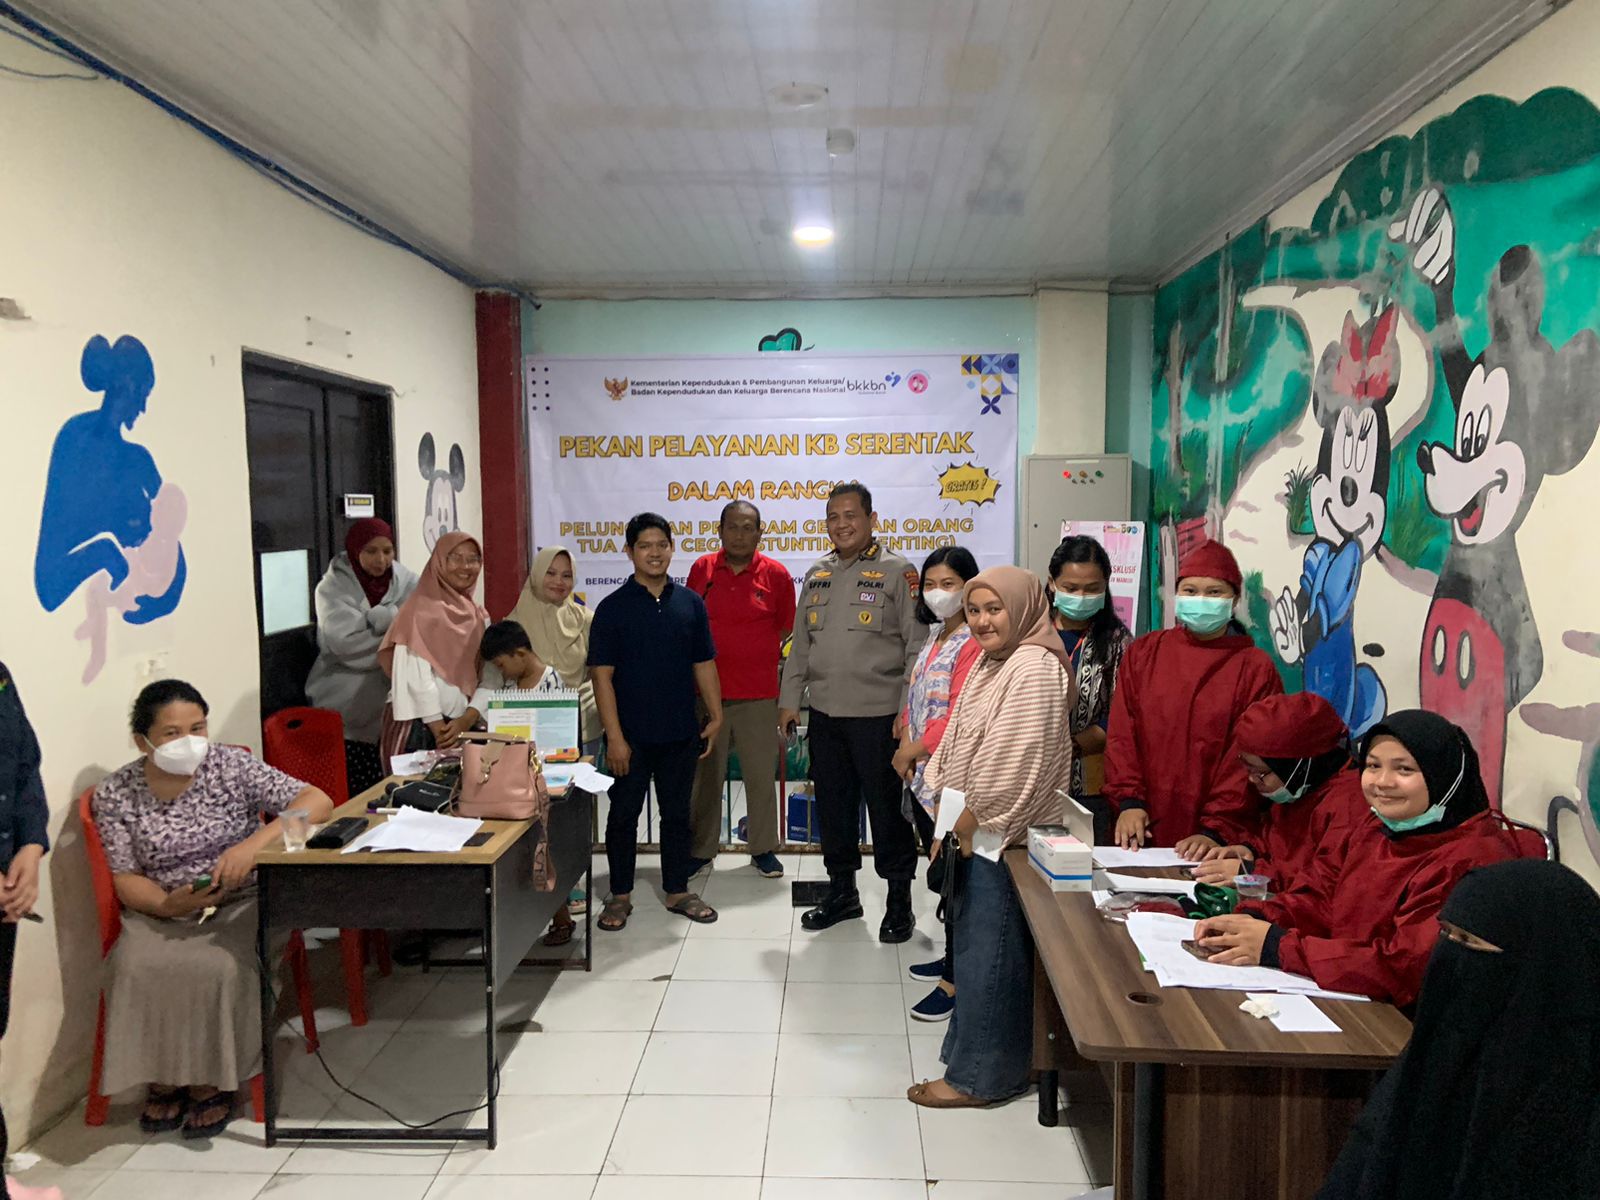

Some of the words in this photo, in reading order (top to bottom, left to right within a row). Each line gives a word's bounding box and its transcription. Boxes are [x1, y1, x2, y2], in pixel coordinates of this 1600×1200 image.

[630, 379, 680, 387] Kementerian
[682, 379, 740, 388] Kependudukan
[750, 378, 805, 387] Pembangunan
[847, 379, 887, 392] bkkbn
[657, 387, 716, 396] Kependudukan
[718, 387, 732, 395] dan
[734, 386, 768, 396] Keluarga
[770, 386, 811, 395] Berencana
[813, 386, 846, 394] Nasional
[559, 435, 643, 457] PEKAN
[649, 433, 799, 457] PELAYANAN
[805, 433, 840, 456] KB
[845, 431, 975, 456] SERENTAK
[668, 479, 754, 501] DALAM
[902, 517, 975, 533] ORANG
[576, 538, 618, 553] TUA
[857, 581, 884, 589] POLRI
